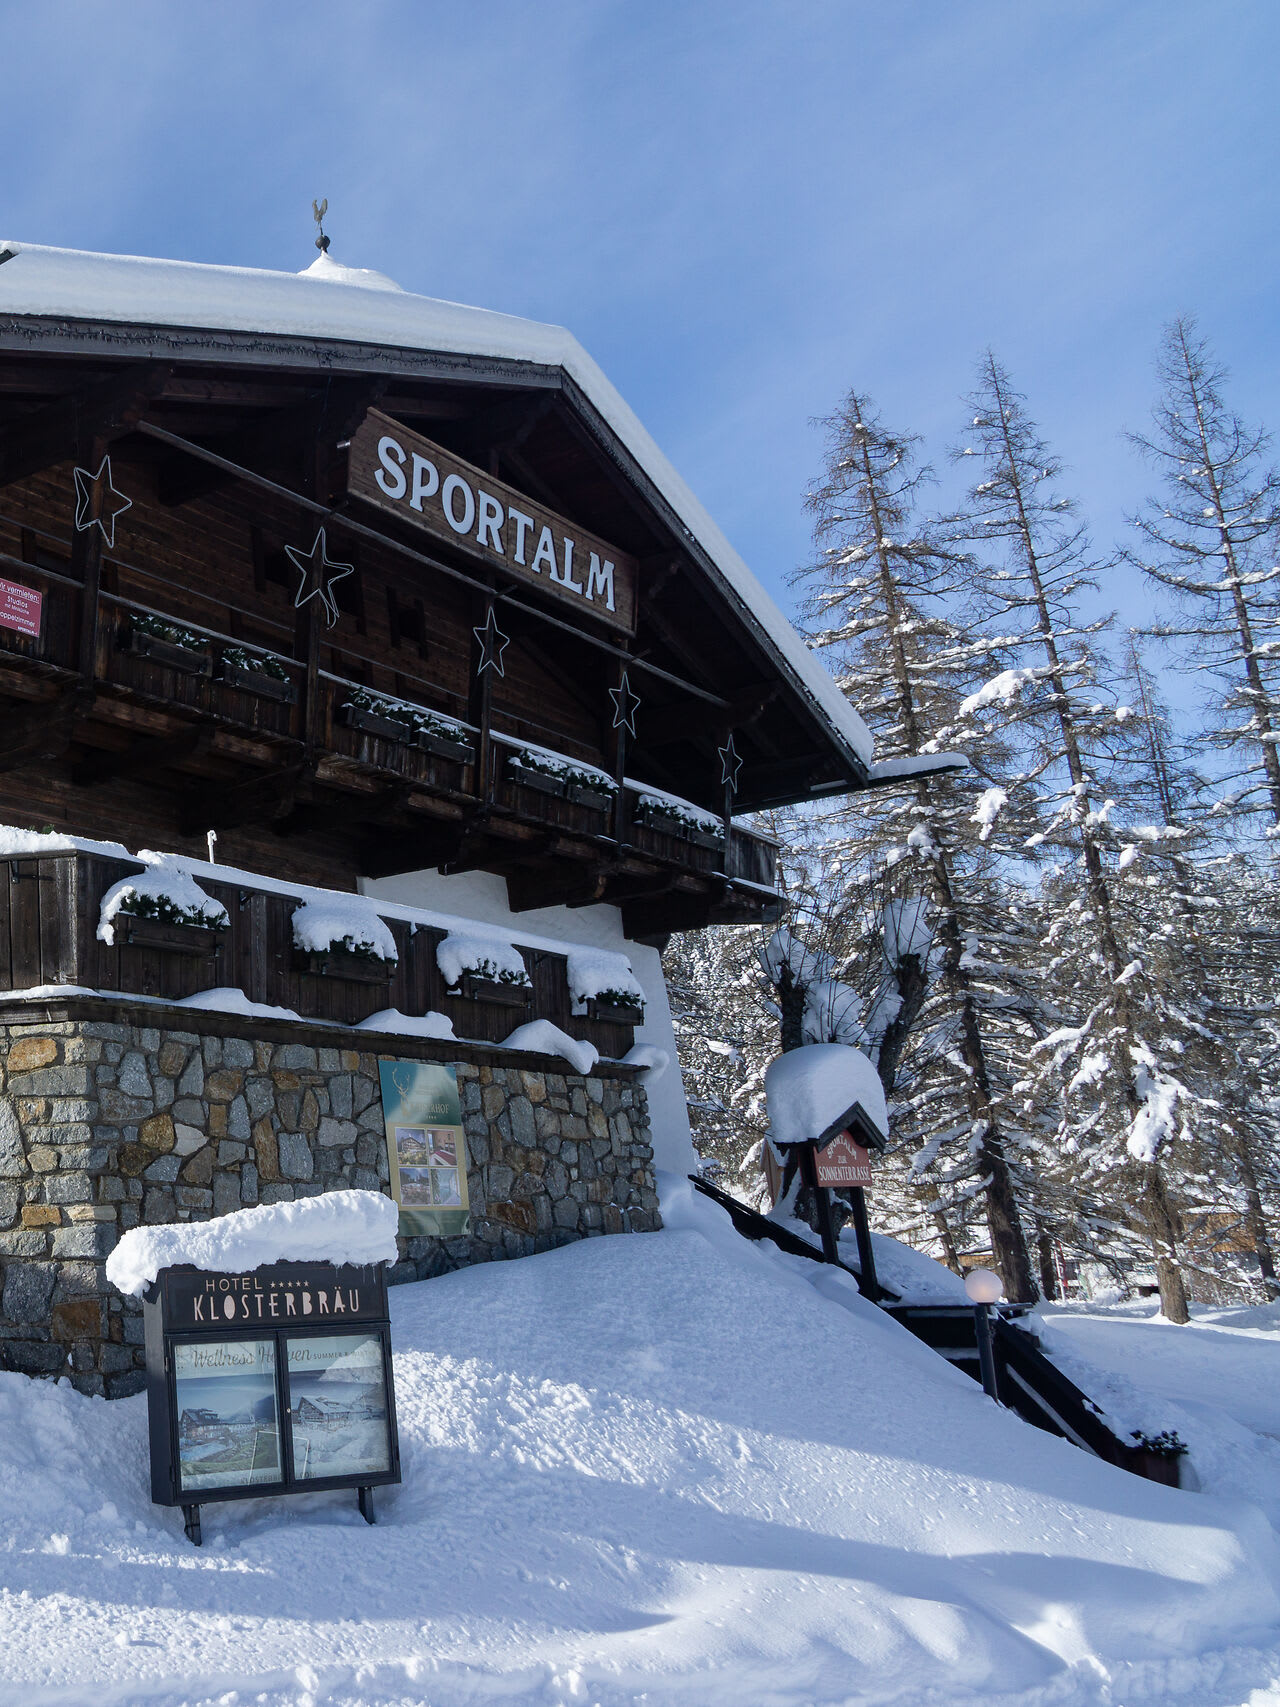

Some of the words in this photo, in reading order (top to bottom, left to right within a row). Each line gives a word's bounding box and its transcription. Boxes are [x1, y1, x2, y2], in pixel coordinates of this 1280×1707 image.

[373, 436, 617, 613] SPORTALM
[7, 595, 28, 608] Studios
[827, 1134, 857, 1160] SPORTALM
[818, 1166, 871, 1181] SONNENTERRASSE
[205, 1277, 264, 1292] HOTEL
[193, 1286, 359, 1321] KLOSTERBRÄU
[192, 1347, 256, 1368] Wellness
